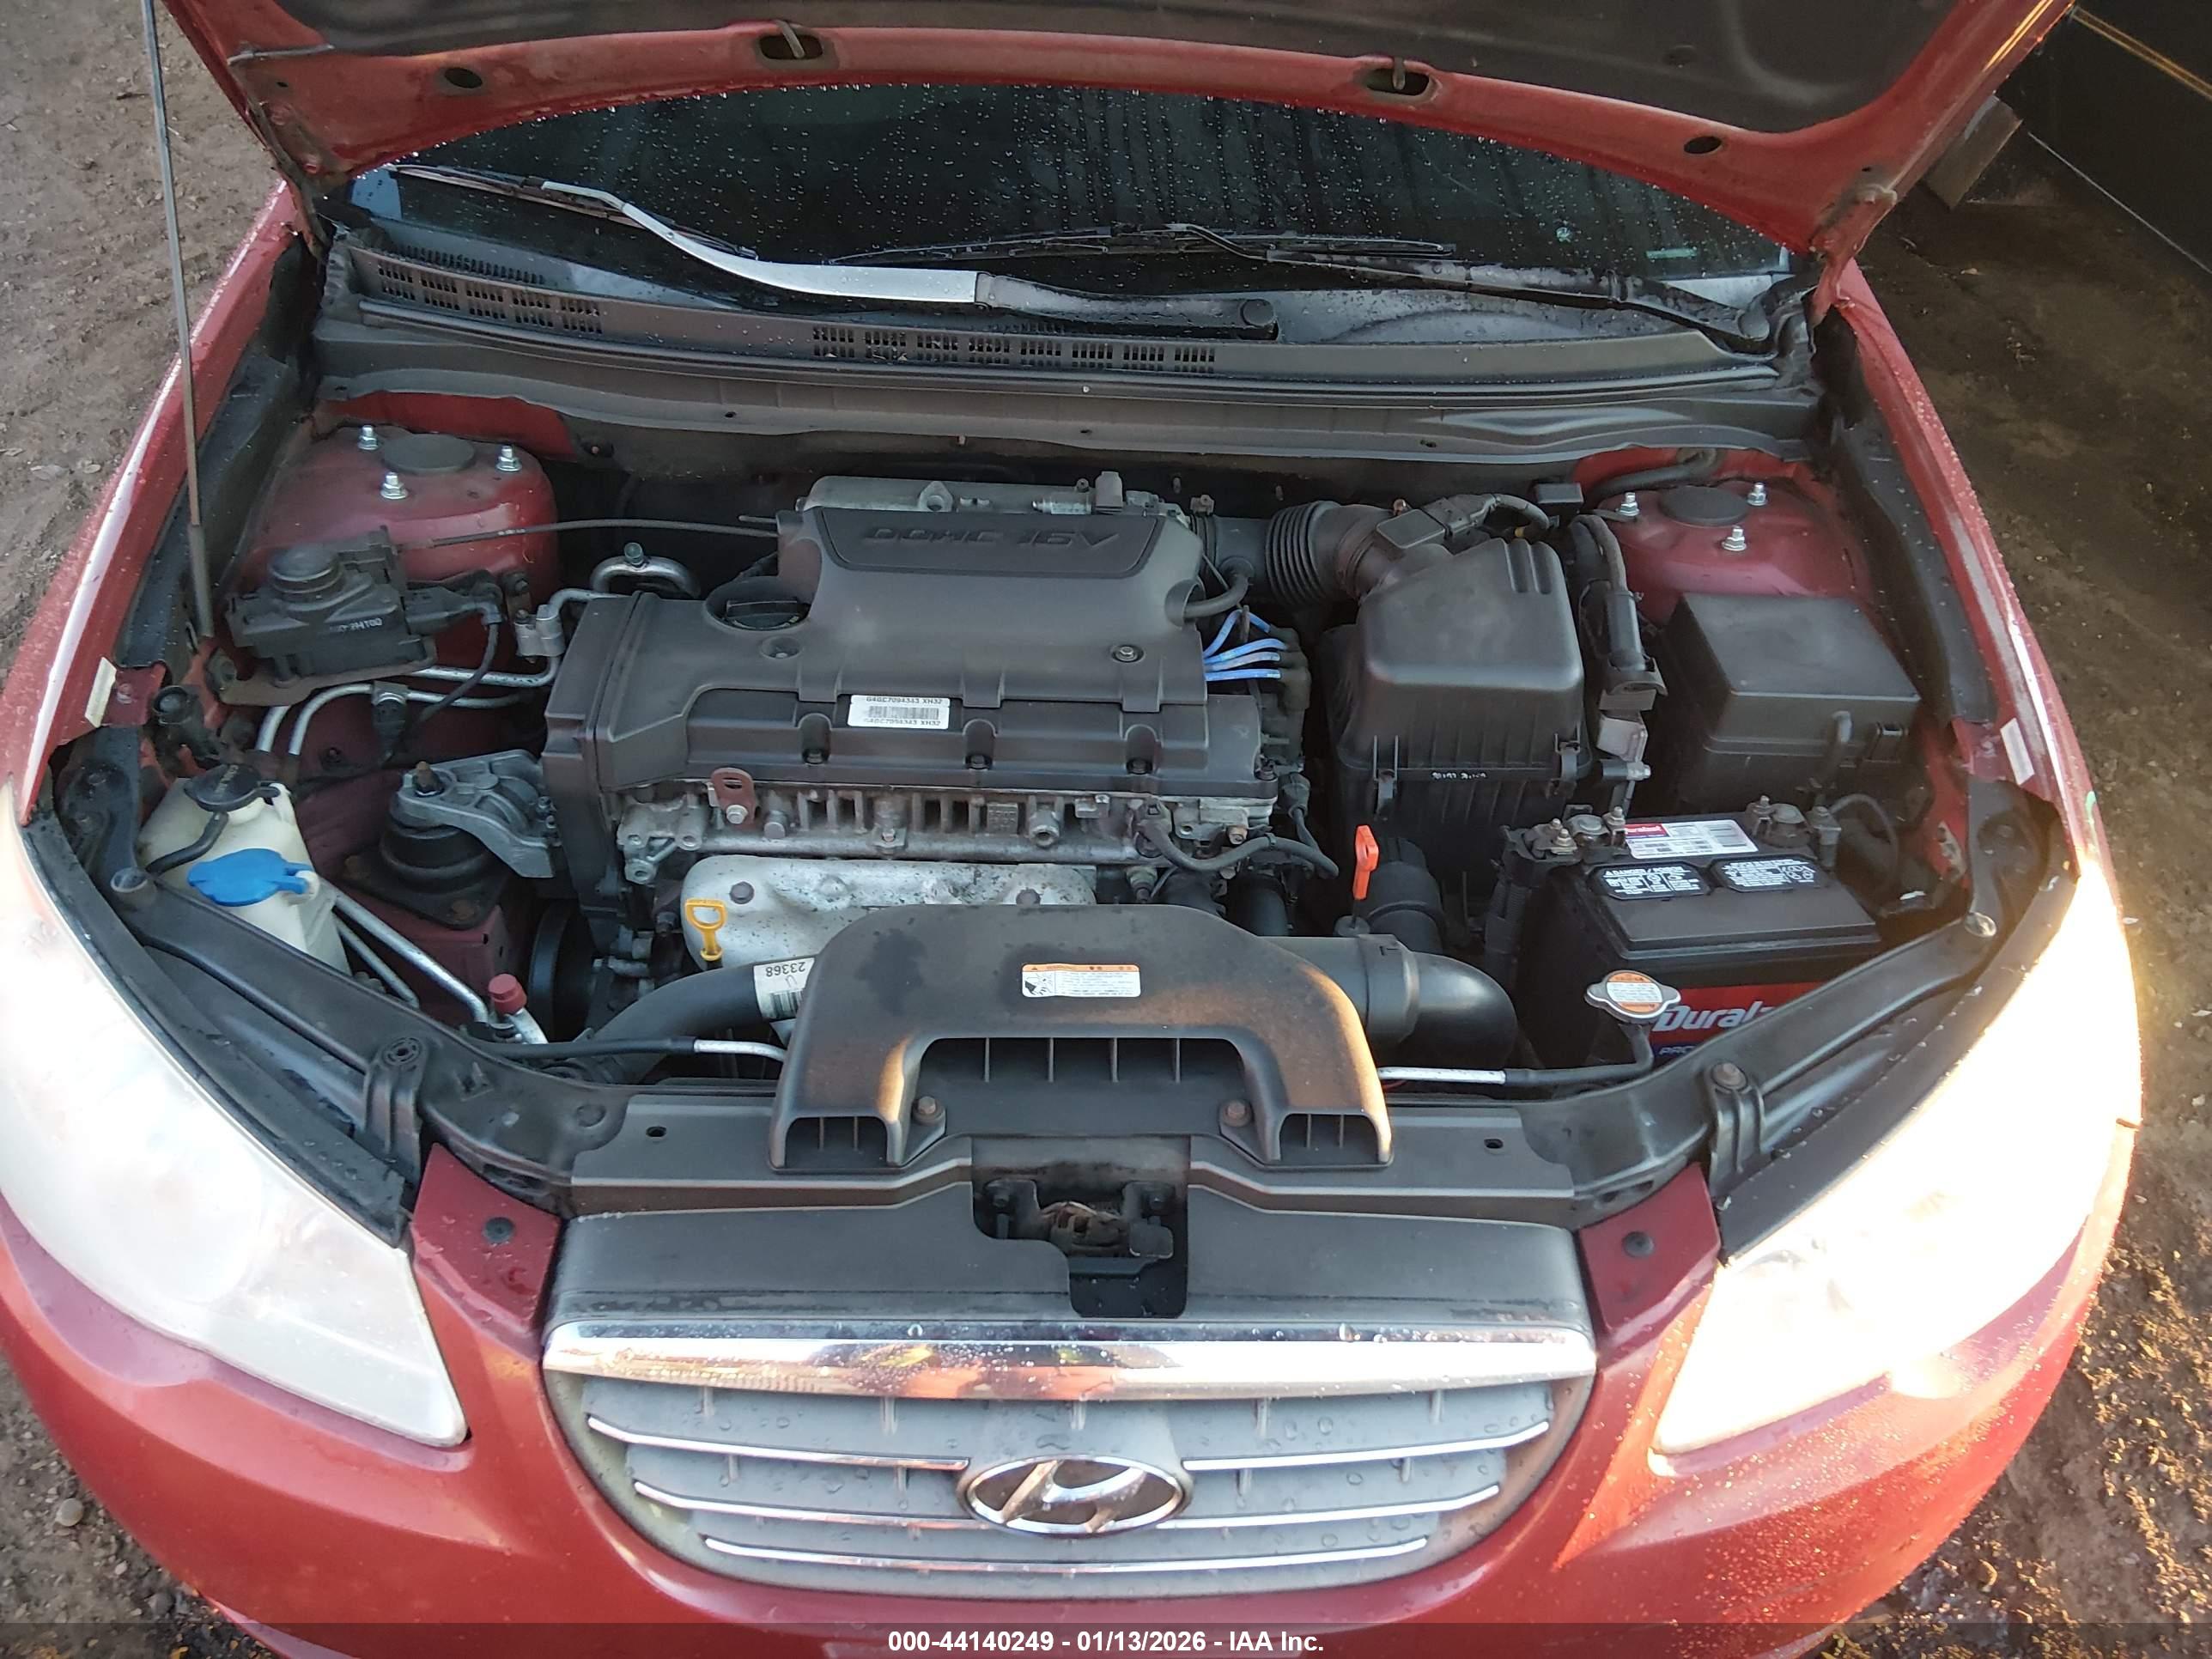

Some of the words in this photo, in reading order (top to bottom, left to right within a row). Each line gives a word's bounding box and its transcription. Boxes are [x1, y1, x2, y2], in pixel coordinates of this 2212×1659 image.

[1017, 530, 1120, 549] 16V
[765, 962, 805, 977] 23368
[1652, 1000, 1775, 1032] Dural
